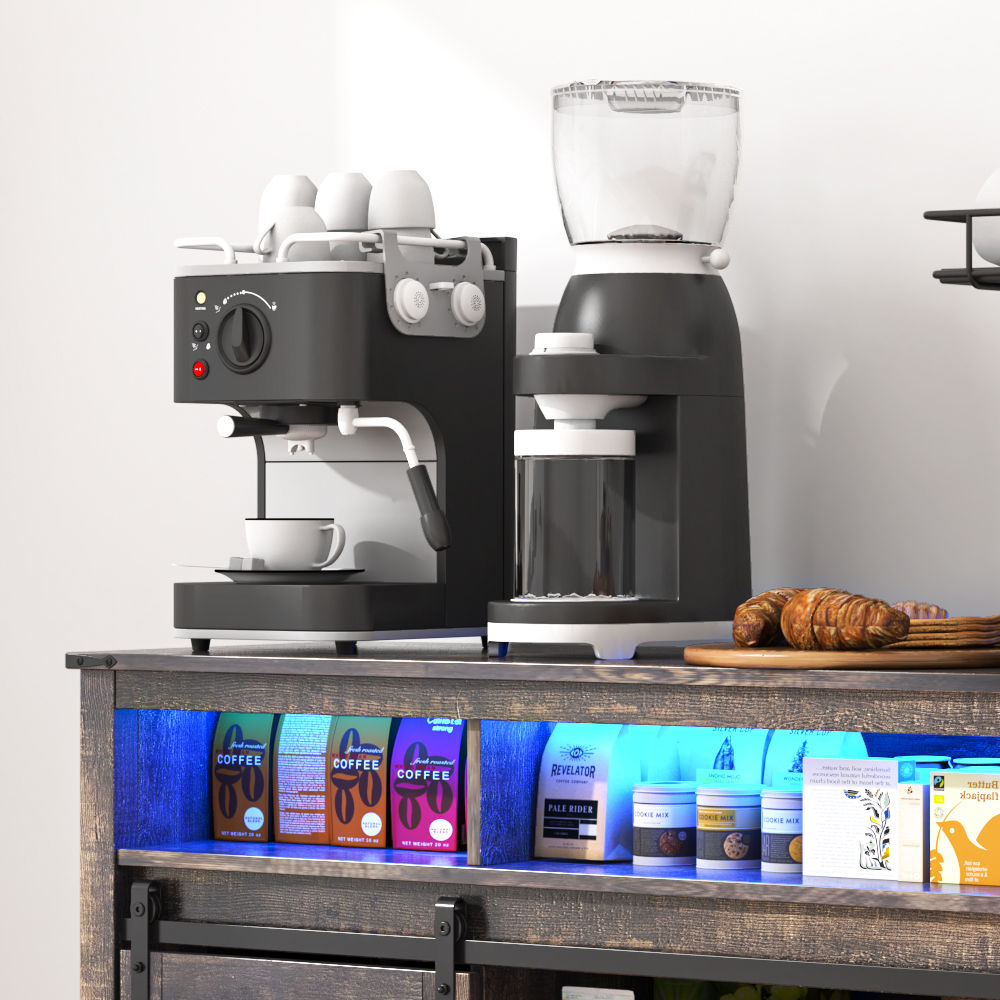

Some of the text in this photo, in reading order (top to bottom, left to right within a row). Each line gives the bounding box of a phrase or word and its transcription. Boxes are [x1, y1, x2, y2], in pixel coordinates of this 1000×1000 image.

[217, 754, 262, 766] COFFEE
[333, 759, 380, 771] COFFEE
[397, 769, 450, 781] COFFEE
[551, 764, 596, 778] REVELATOR
[548, 804, 593, 814] PALE RIDER
